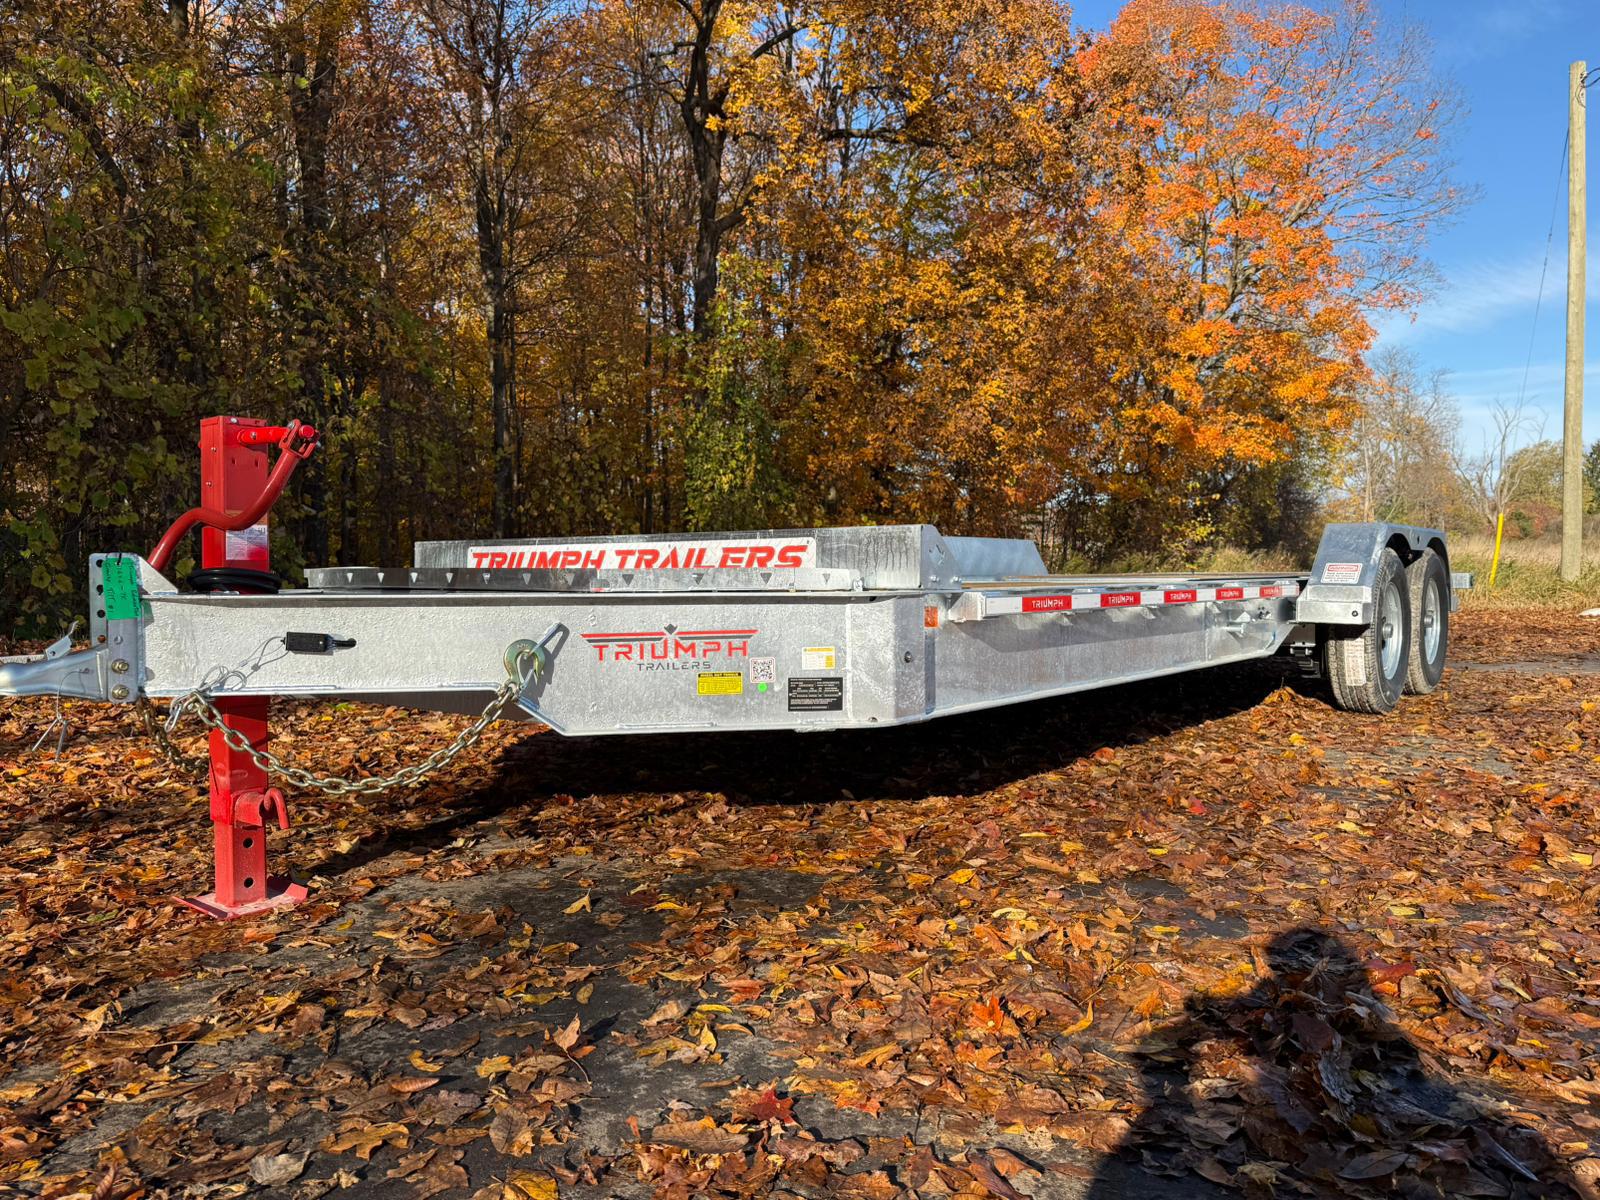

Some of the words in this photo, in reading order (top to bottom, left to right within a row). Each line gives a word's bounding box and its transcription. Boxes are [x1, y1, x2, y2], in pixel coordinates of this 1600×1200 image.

[472, 550, 606, 570] TRIUMPH
[615, 544, 808, 569] TRAILERS
[1108, 594, 1134, 605] TRIUMPH
[1170, 591, 1192, 601] TRIUMPH
[1031, 598, 1064, 609] TRIUMPH
[592, 638, 749, 661] TRIUMPH
[636, 661, 712, 671] TRAILERS
